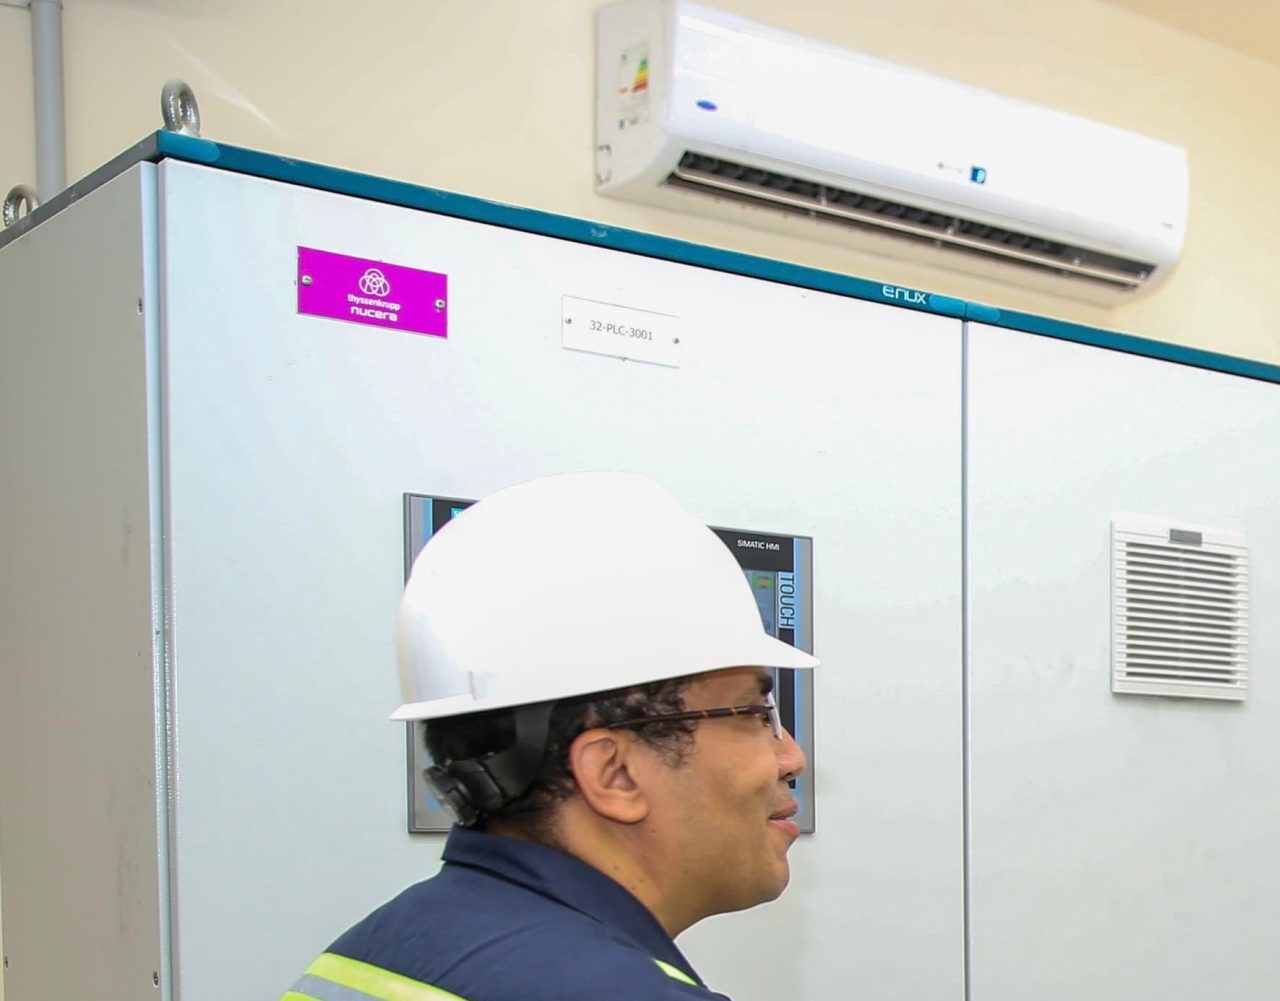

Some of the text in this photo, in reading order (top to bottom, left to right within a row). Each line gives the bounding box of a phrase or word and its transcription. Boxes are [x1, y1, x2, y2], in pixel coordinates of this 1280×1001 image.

[347, 293, 401, 311] thyssenkrupp
[882, 284, 927, 305] enux
[350, 306, 398, 321] nucera
[590, 319, 653, 341] 32-PLC-3001
[737, 539, 780, 551] SIMATIC HMI
[780, 574, 795, 627] TOUCH
